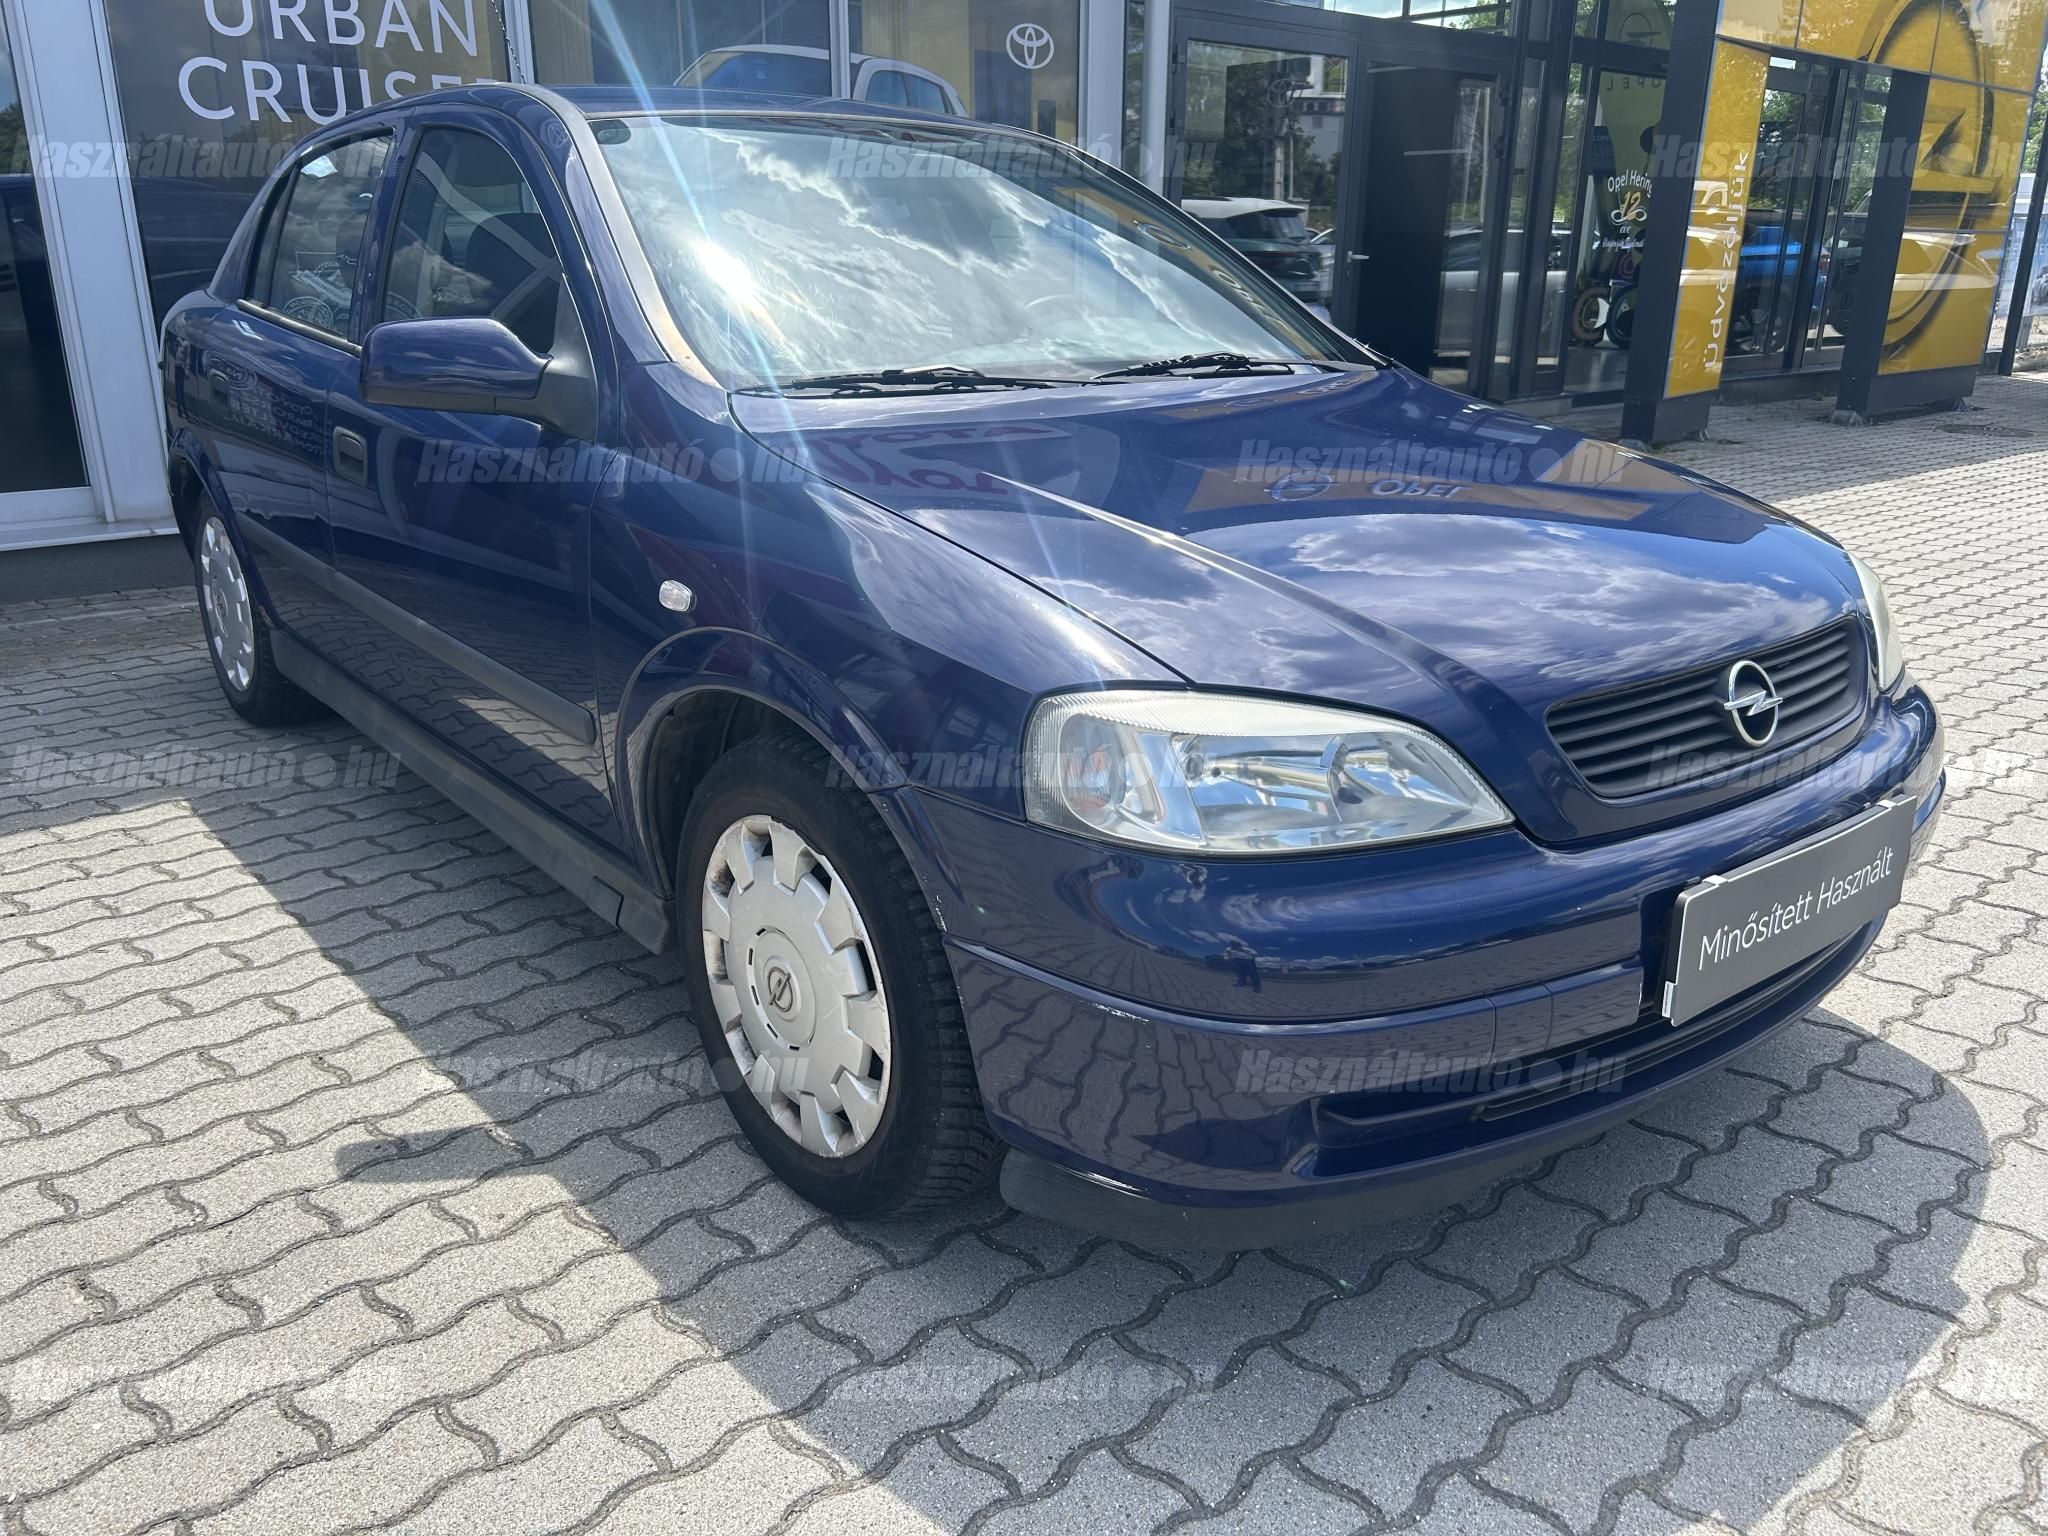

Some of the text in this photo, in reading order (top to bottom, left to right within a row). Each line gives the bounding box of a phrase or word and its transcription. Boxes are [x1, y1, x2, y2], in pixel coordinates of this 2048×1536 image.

[204, 0, 479, 57] URBAN
[178, 56, 507, 126] CRUI
[1607, 169, 1629, 192] Opel
[1703, 151, 1749, 368] Üdvözöljük
[1699, 846, 1893, 971] Minősített Használt
